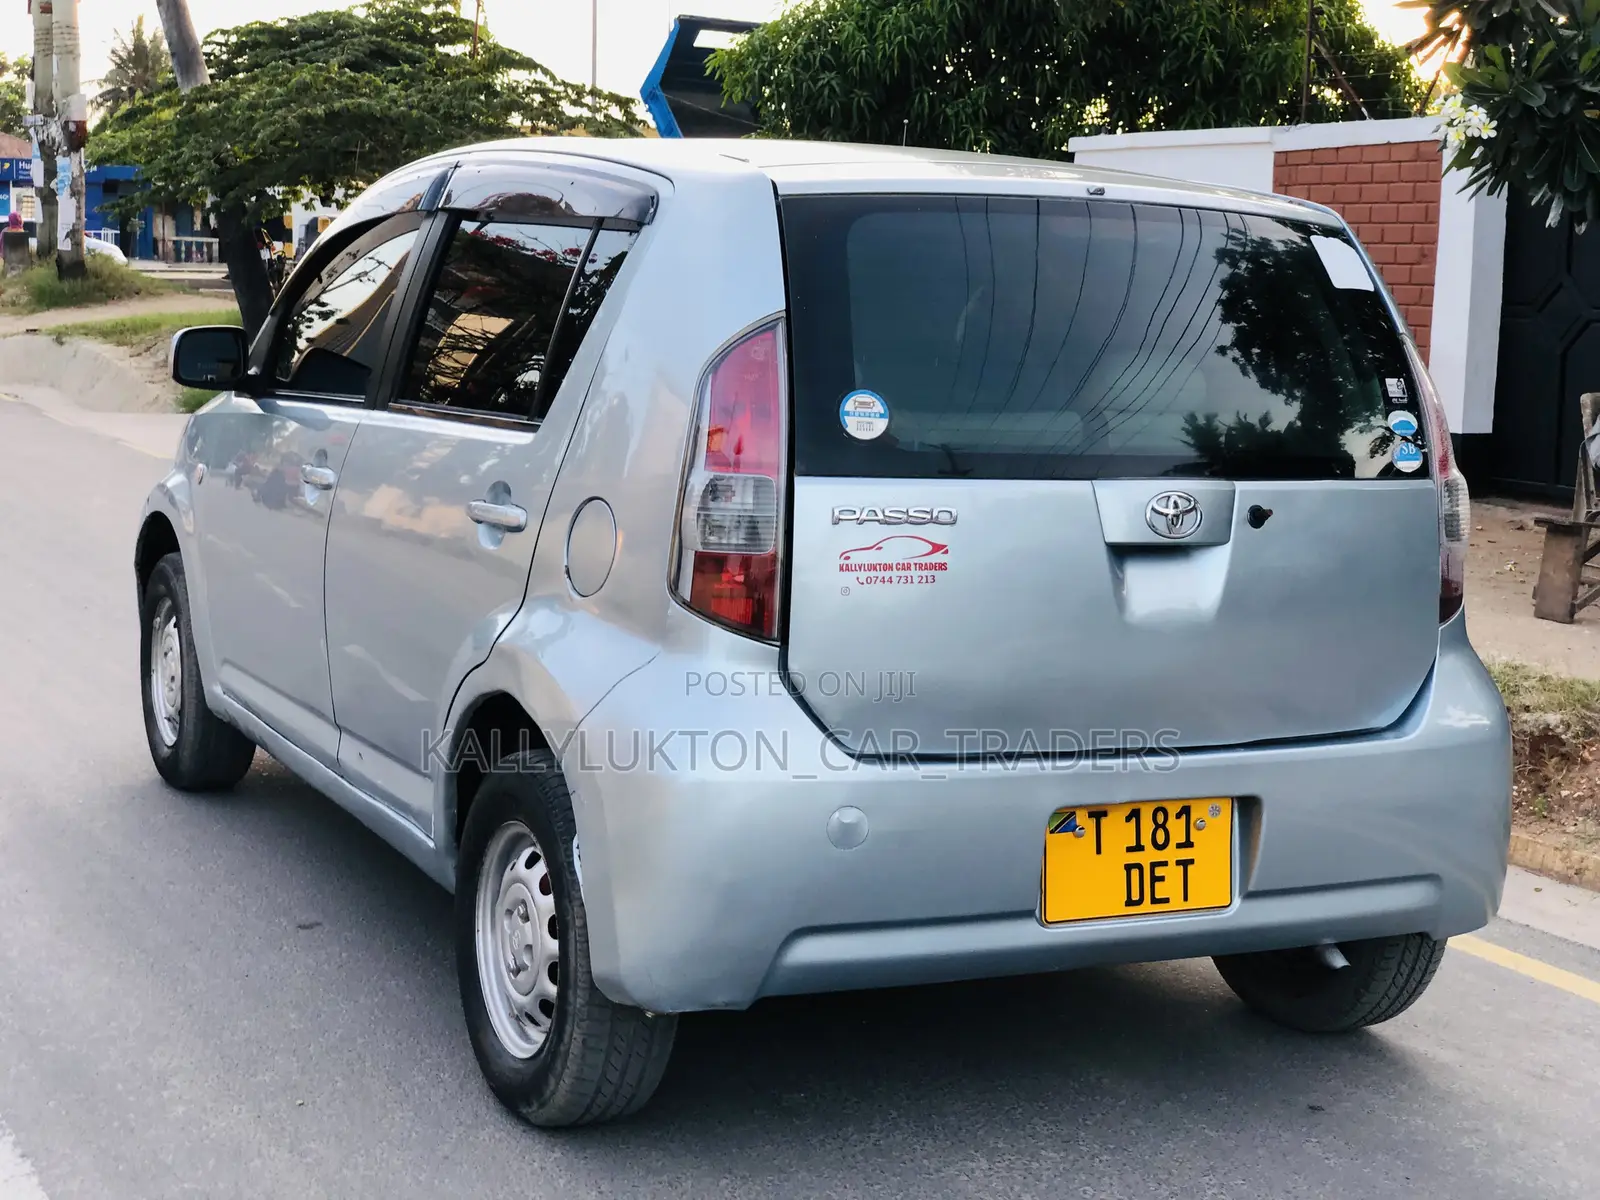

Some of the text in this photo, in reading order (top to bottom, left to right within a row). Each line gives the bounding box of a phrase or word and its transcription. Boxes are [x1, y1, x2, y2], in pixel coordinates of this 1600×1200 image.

[832, 506, 957, 525] PASSO
[838, 562, 948, 572] KALLYLUKTON CAR TRADERS
[865, 575, 936, 584] 0744 731 213
[1088, 805, 1195, 855] T 181
[1124, 858, 1195, 907] DET
